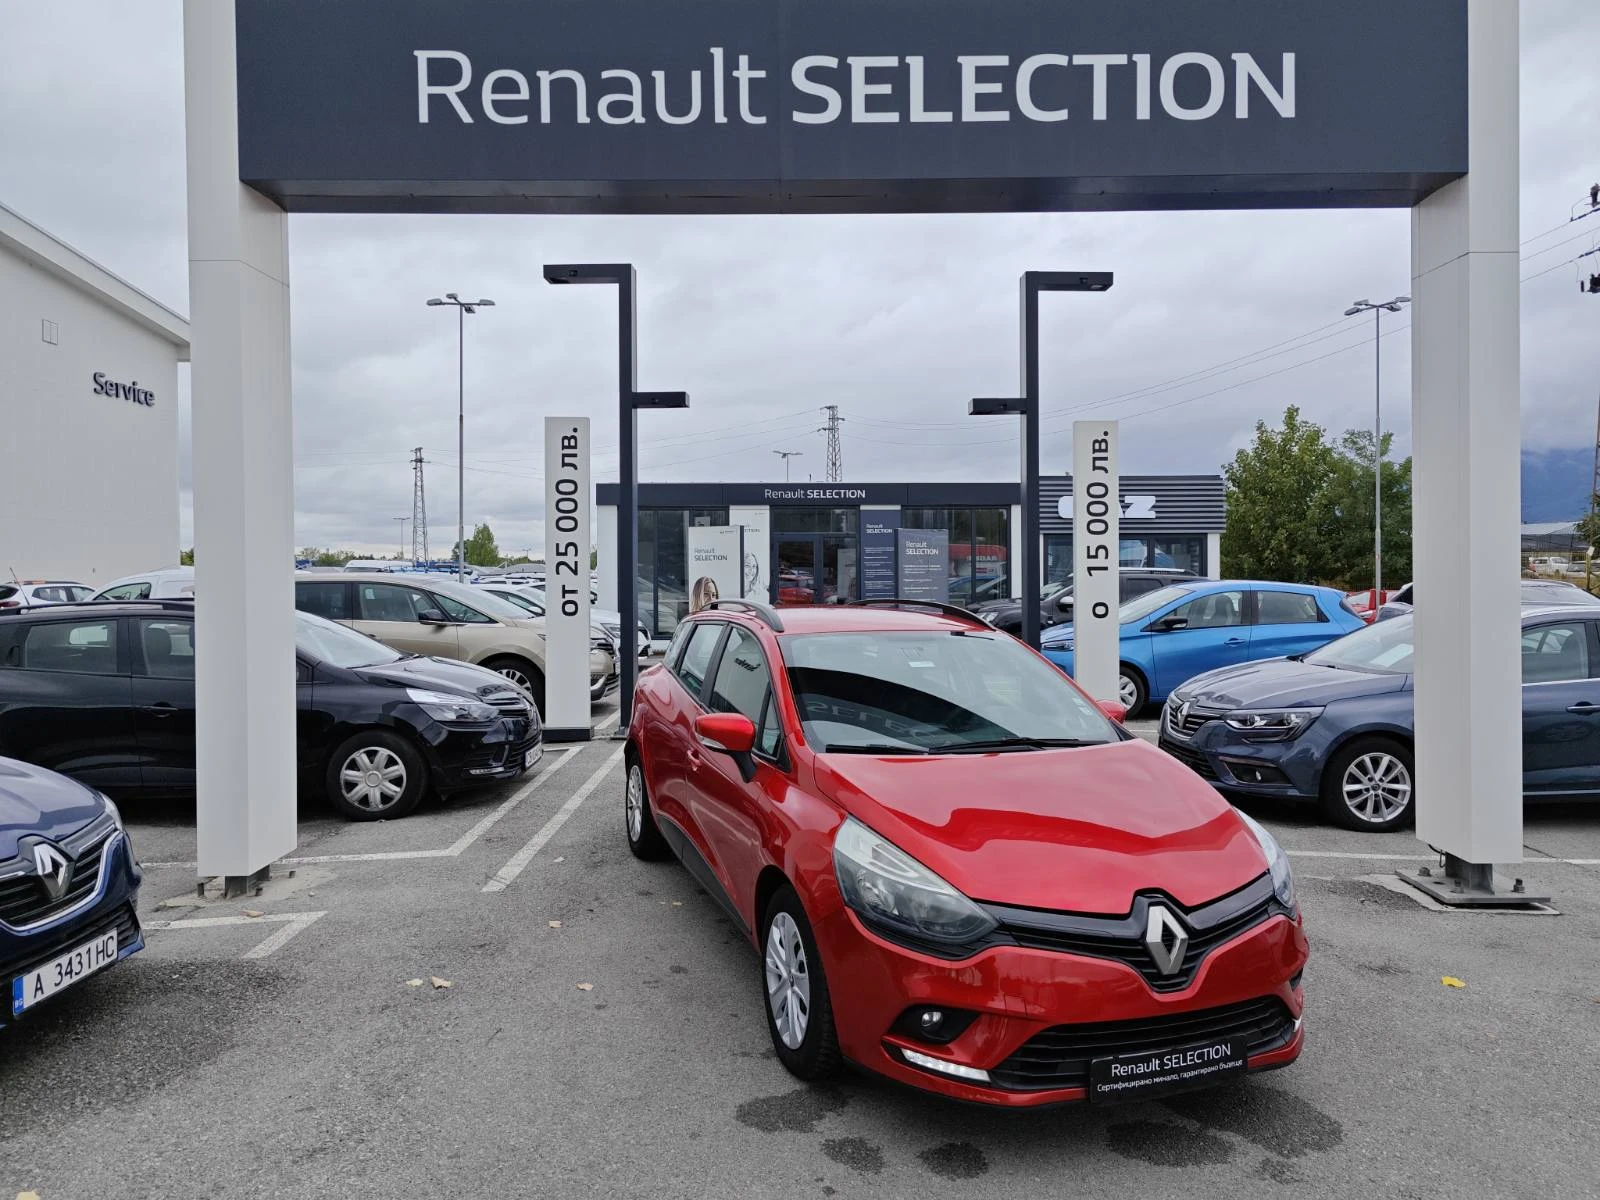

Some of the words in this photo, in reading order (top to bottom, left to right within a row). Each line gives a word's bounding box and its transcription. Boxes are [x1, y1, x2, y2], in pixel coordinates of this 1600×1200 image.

[413, 47, 767, 125] Renault
[791, 51, 1296, 124] SELECTION
[93, 371, 155, 407] Service
[561, 427, 578, 471] лв.
[1092, 430, 1109, 474] лв.
[555, 478, 579, 533] 000
[764, 488, 805, 499] Renault
[806, 489, 866, 499] SELECTION
[1086, 481, 1109, 535] 000
[555, 541, 579, 576] 25
[905, 548, 939, 556] SELECTION
[1086, 544, 1109, 577] 15
[561, 584, 579, 617] от
[33, 972, 44, 999] A
[54, 946, 92, 987] 3431
[95, 935, 115, 965] HC
[1111, 1058, 1161, 1077] Renault
[1163, 1043, 1231, 1069] SELECTION
[1097, 1079, 1152, 1092] Сертифицирано
